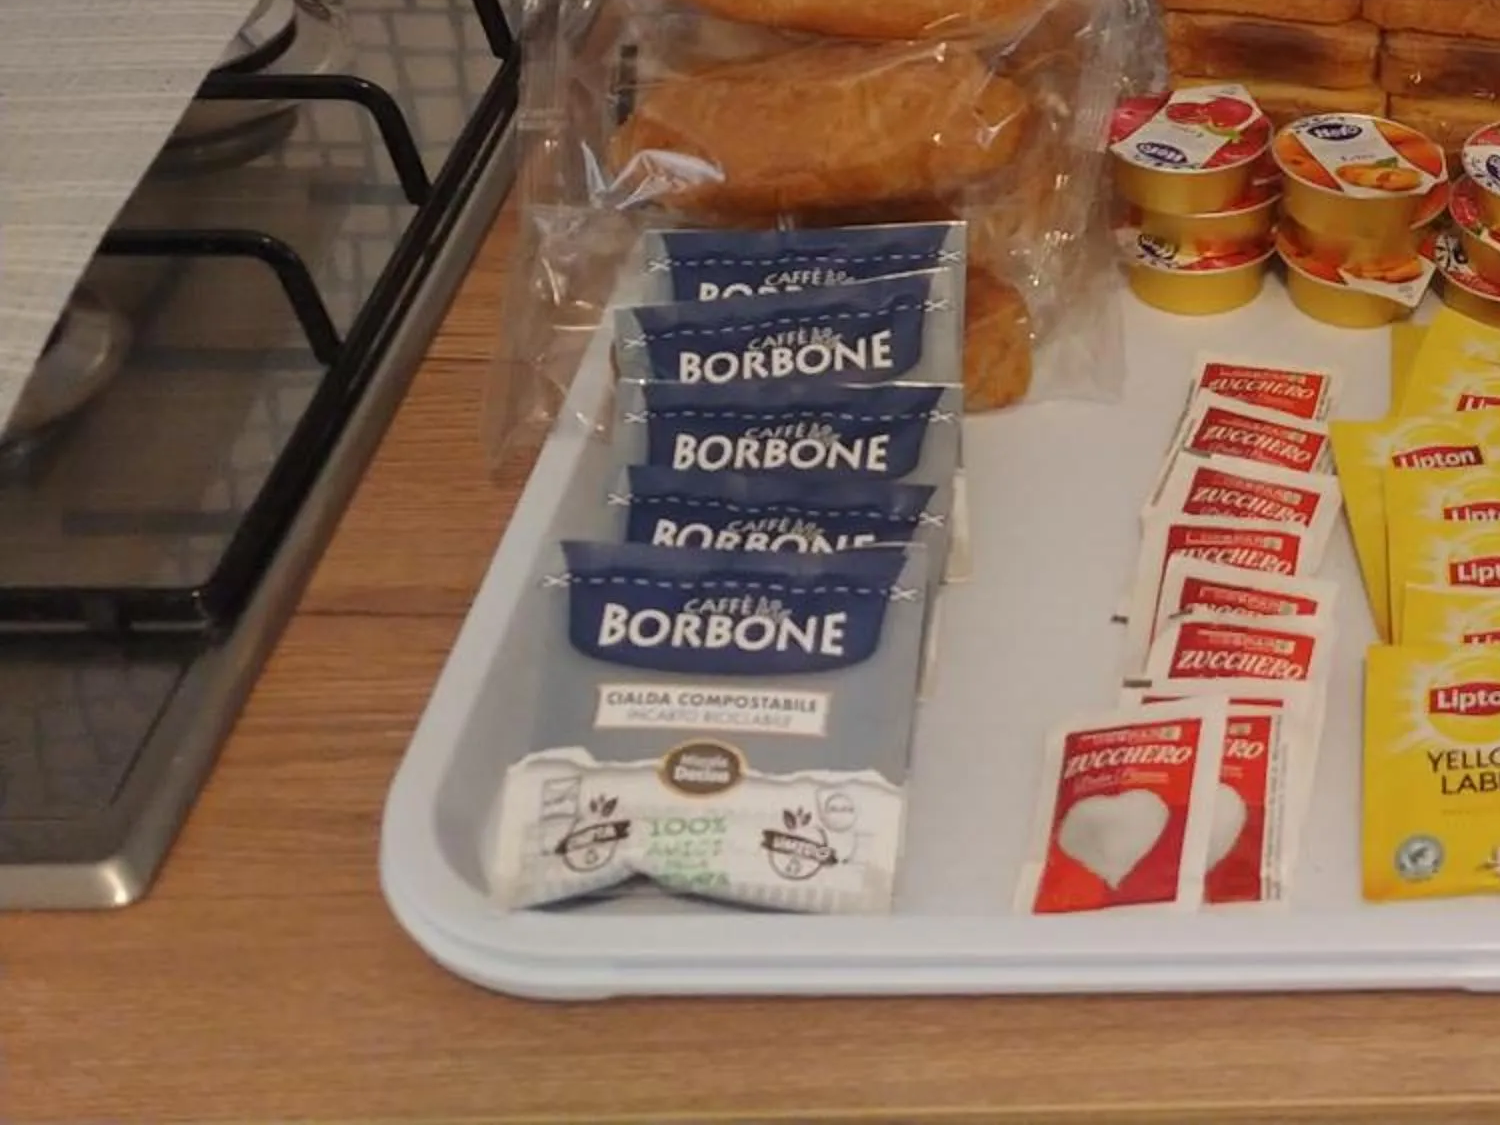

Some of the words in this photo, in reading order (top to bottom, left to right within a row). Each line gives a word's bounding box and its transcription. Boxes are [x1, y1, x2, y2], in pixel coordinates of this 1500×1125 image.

[679, 329, 893, 384] BORBONE
[1208, 377, 1315, 400] ZUCCHERO
[672, 433, 890, 471] BORBONE
[1202, 425, 1312, 464] ZUCCHERO
[1400, 447, 1476, 469] Lipton
[1191, 486, 1307, 525] ZUCCHERO
[598, 602, 848, 656] BORBONE
[1176, 650, 1304, 679] ZUCCHERO
[606, 690, 671, 709] CIALDA
[677, 691, 817, 714] COMPOSTABILE
[1064, 744, 1194, 780] ZUCCHERO
